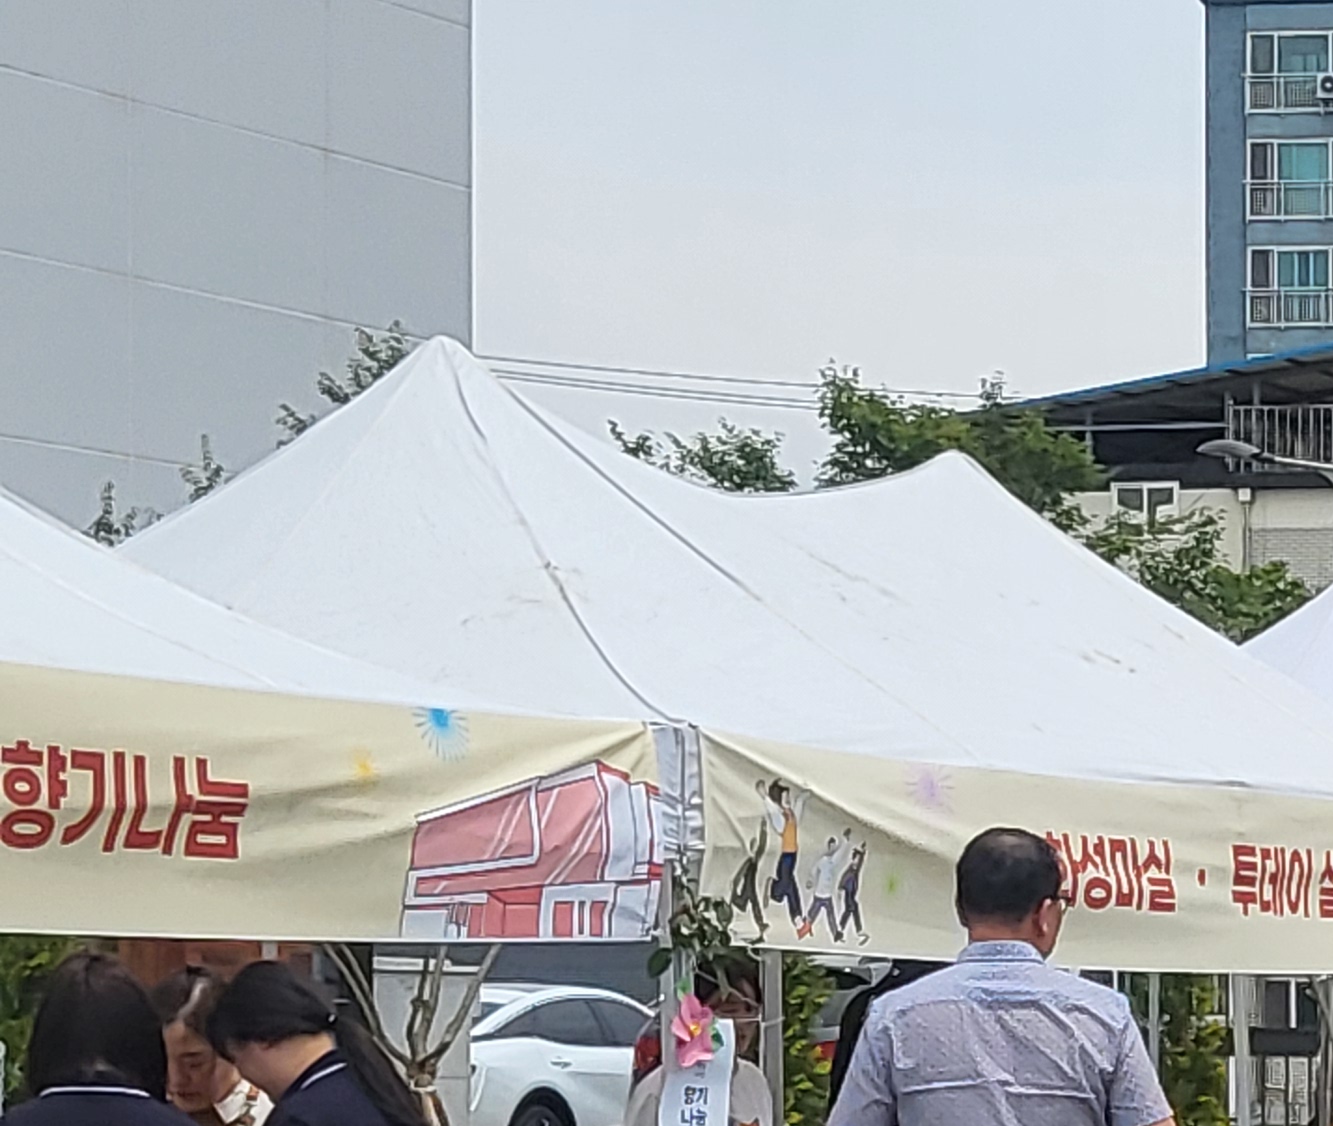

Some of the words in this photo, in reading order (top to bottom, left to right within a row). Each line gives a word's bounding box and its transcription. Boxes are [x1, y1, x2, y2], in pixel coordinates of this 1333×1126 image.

[0, 740, 250, 860] 향기나눔
[1231, 844, 1312, 918] 투데이
[683, 1084, 709, 1106] 향기
